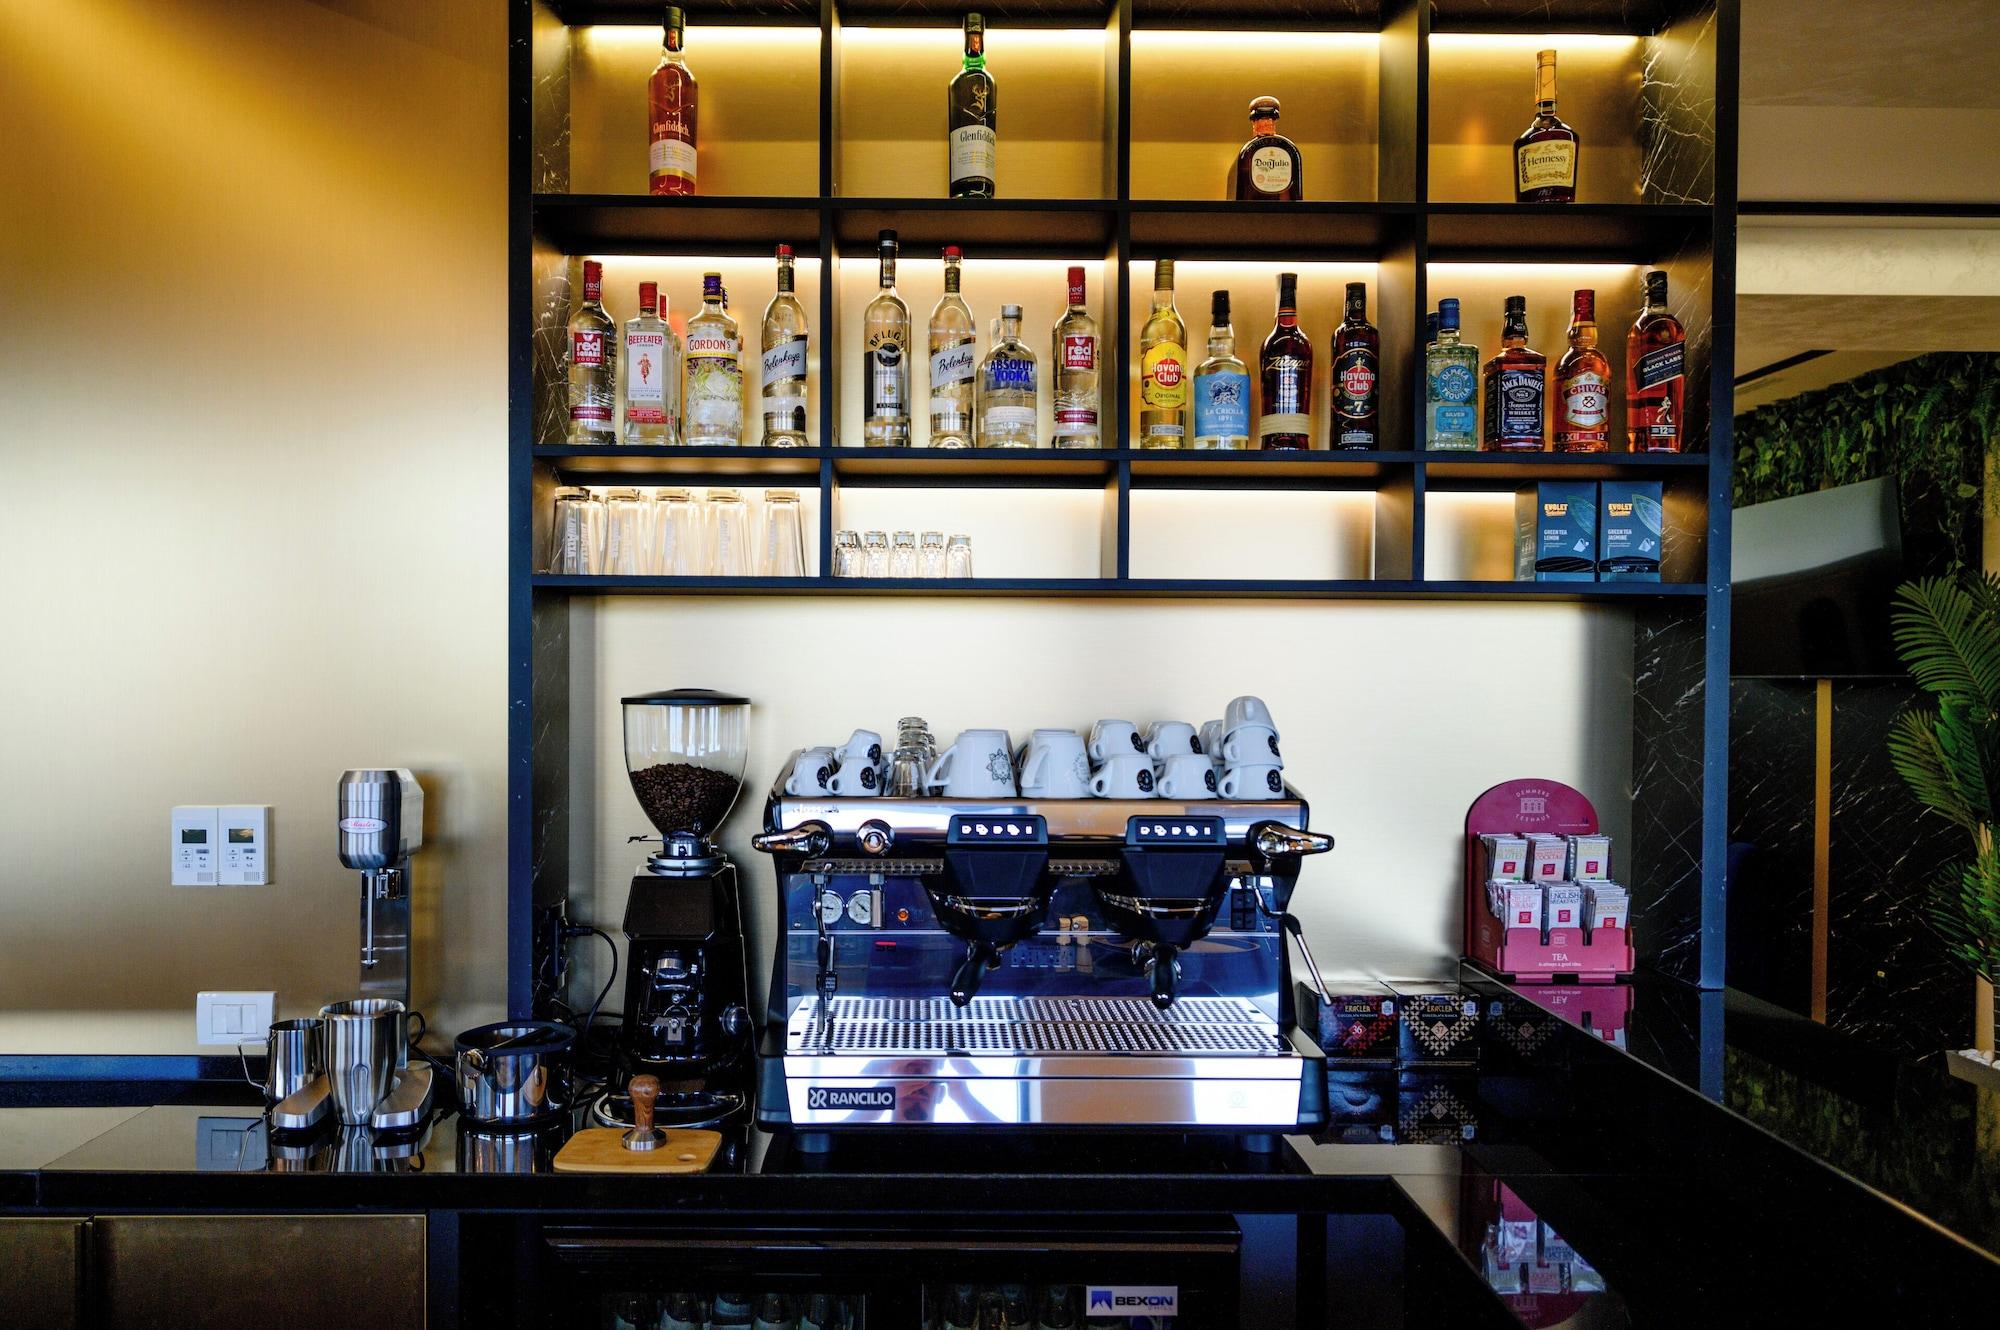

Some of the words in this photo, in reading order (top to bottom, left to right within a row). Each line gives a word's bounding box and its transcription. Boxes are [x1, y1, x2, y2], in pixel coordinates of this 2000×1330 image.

[1527, 155, 1567, 167] Hennessy
[576, 338, 600, 351] red
[628, 335, 662, 346] BEEFEATER
[1067, 342, 1091, 356] red
[990, 358, 1034, 372] ABSOLUT
[1642, 361, 1665, 373] BLACK
[994, 370, 1031, 382] VODKA
[1157, 372, 1179, 383] Club
[1340, 371, 1376, 382] Havana
[1347, 381, 1370, 391] Club
[1502, 379, 1519, 391] JACK
[1570, 385, 1606, 395] CHIVAS
[1442, 387, 1471, 400] TEQUILA
[1354, 401, 1364, 413] 7
[1597, 432, 1605, 440] 12
[1660, 426, 1669, 435] 12
[1552, 953, 1568, 961] TEA
[1353, 1025, 1363, 1035] 36
[1435, 1025, 1445, 1035] 37
[829, 1092, 893, 1105] RANCILIO
[1115, 1296, 1174, 1306] BEXON
